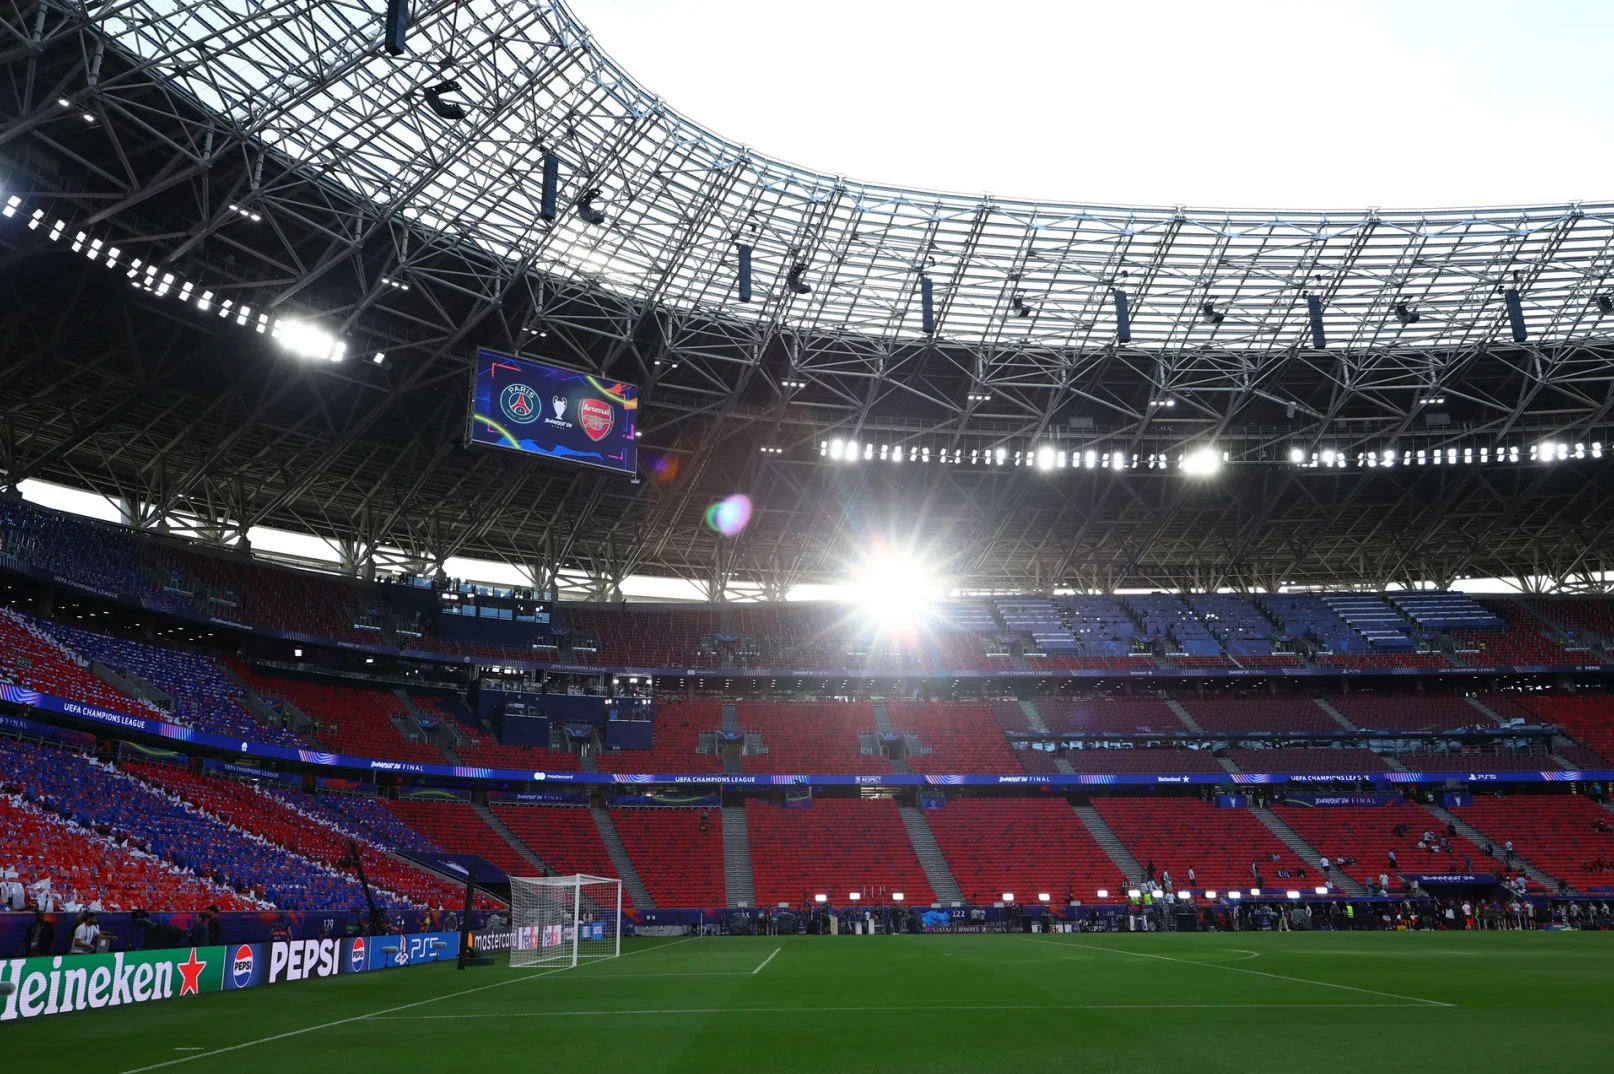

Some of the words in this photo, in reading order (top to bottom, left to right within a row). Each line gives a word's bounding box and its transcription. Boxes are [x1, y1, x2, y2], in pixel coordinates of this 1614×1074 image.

[508, 385, 536, 398] PARIS
[583, 403, 610, 416] Arsenal
[53, 575, 67, 584] UEFA
[68, 579, 97, 593] CHAMPIONS
[98, 588, 118, 599] LEAGUE
[63, 703, 81, 714] UEFA
[82, 707, 121, 724] CHAMPIONS
[121, 717, 146, 729] LEAGUE
[5, 717, 28, 730] FINAL
[224, 763, 236, 771] UEFA
[236, 765, 261, 776] CHAMPIONS
[261, 769, 279, 778] LEAGUE
[402, 763, 424, 772] FINAL
[861, 775, 882, 783] RESPECT
[952, 910, 965, 918] 122
[474, 930, 517, 951] mastercard
[352, 949, 364, 959] PEPSI
[234, 960, 252, 970] PEPSI
[268, 938, 341, 984] PEPSI
[0, 952, 173, 1021] Heineken
